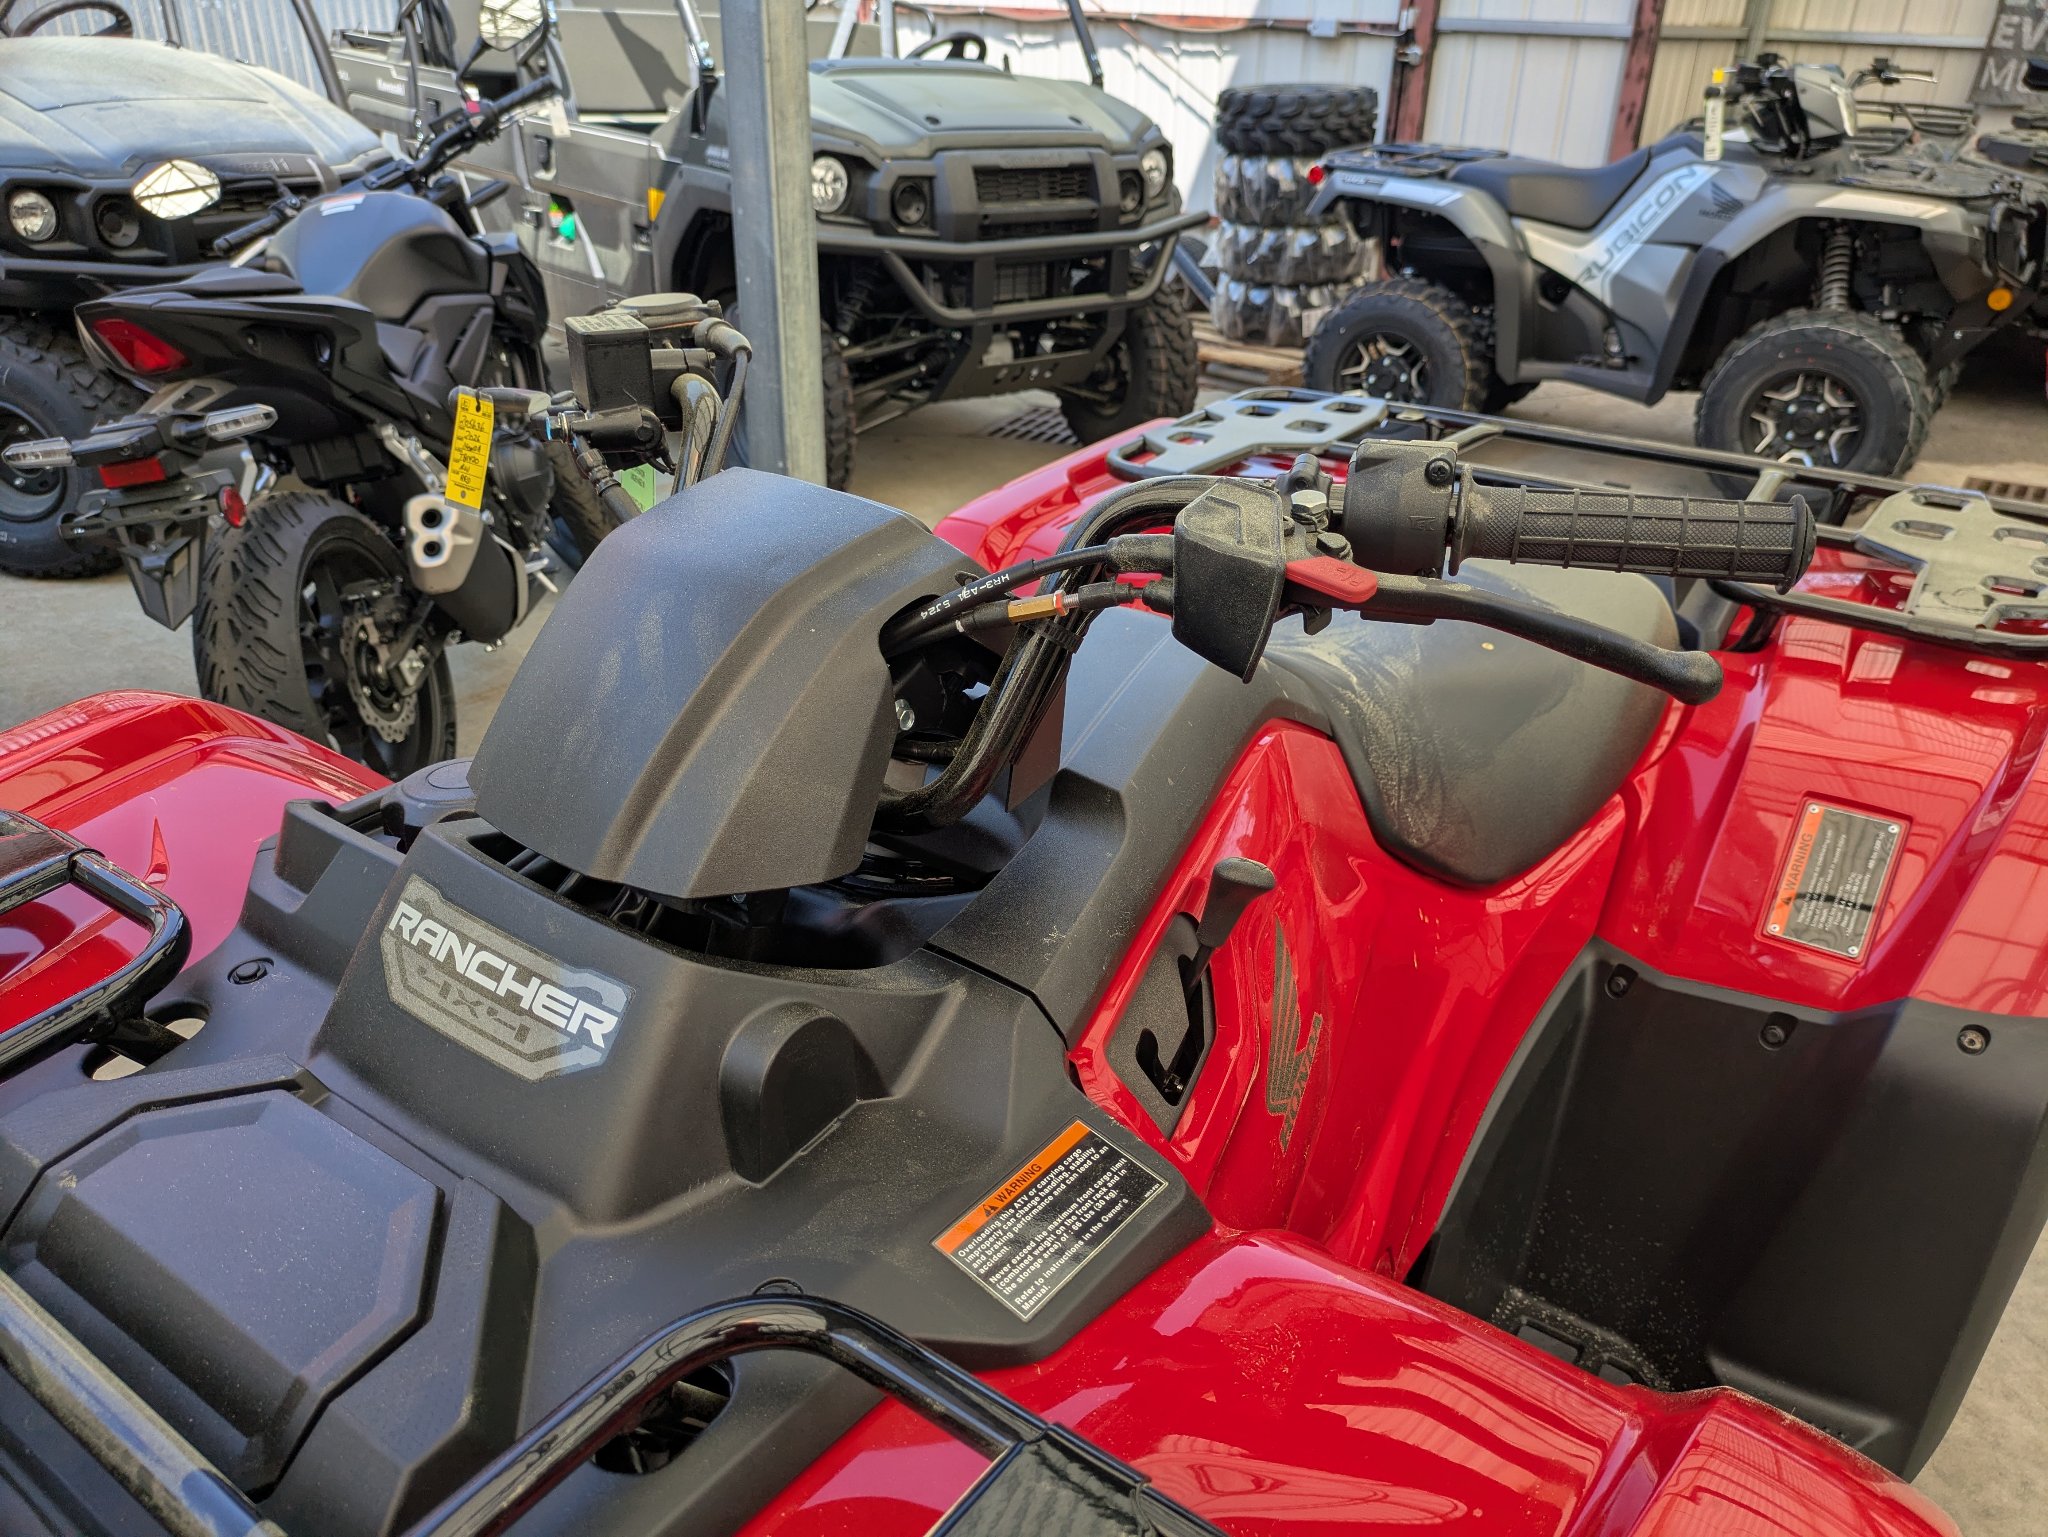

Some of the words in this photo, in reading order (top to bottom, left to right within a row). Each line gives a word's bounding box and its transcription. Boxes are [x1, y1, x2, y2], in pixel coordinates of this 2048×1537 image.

[1576, 168, 1698, 283] RUBICON
[1784, 832, 1813, 892] WARNING
[388, 900, 618, 1048] RANCHER
[956, 1219, 1002, 1258] Overloading
[998, 1206, 1015, 1220] this
[1012, 1194, 1029, 1208] ATV
[1027, 1187, 1037, 1196] or
[1035, 1164, 1065, 1189] carrying
[1062, 1148, 1084, 1166] cargo
[963, 1228, 1004, 1263] improperly
[1001, 1217, 1016, 1229] can
[1013, 1195, 1041, 1218] change
[1038, 1168, 1071, 1197] handling,
[1067, 1146, 1096, 1171] stability
[970, 1254, 986, 1268] and
[984, 1230, 1014, 1256] braking
[1011, 1194, 1055, 1232] performance
[1051, 1183, 1066, 1195] and
[1065, 1172, 1079, 1184] can
[1076, 1159, 1093, 1173] lead
[1090, 1152, 1100, 1160] to
[1098, 1145, 1109, 1154] an
[988, 1262, 1012, 1283] Never
[1009, 1240, 1036, 1264] exceed
[1033, 1229, 1048, 1242] the
[1045, 1201, 1079, 1231] maximum
[1075, 1186, 1095, 1203] front
[1092, 1171, 1114, 1189] cargo
[1109, 1157, 1127, 1172] limit
[994, 1162, 1043, 1203] WARNING
[995, 1254, 1035, 1290] (combined
[1031, 1233, 1057, 1256] weight
[1054, 1225, 1066, 1235] on
[1063, 1213, 1077, 1226] the
[1074, 1199, 1093, 1215] front
[1090, 1185, 1108, 1200] rack
[1105, 1174, 1120, 1187] and
[1117, 1168, 1127, 1176] in
[977, 1243, 1011, 1273] accident.
[1001, 1281, 1017, 1294] the
[1014, 1256, 1044, 1283] storage
[1041, 1240, 1062, 1259] area)
[1058, 1232, 1069, 1242] of
[1071, 1220, 1082, 1230] 66
[1079, 1209, 1095, 1222] Lbs
[1092, 1198, 1107, 1211] (30
[1103, 1187, 1120, 1201] kg).
[1013, 1283, 1037, 1304] Refer
[1033, 1276, 1045, 1286] to
[1041, 1238, 1084, 1278] instructions
[1081, 1231, 1092, 1240] in
[1089, 1220, 1103, 1233] the
[1100, 1197, 1128, 1223] Owner's
[1020, 1282, 1051, 1310] Manual.
